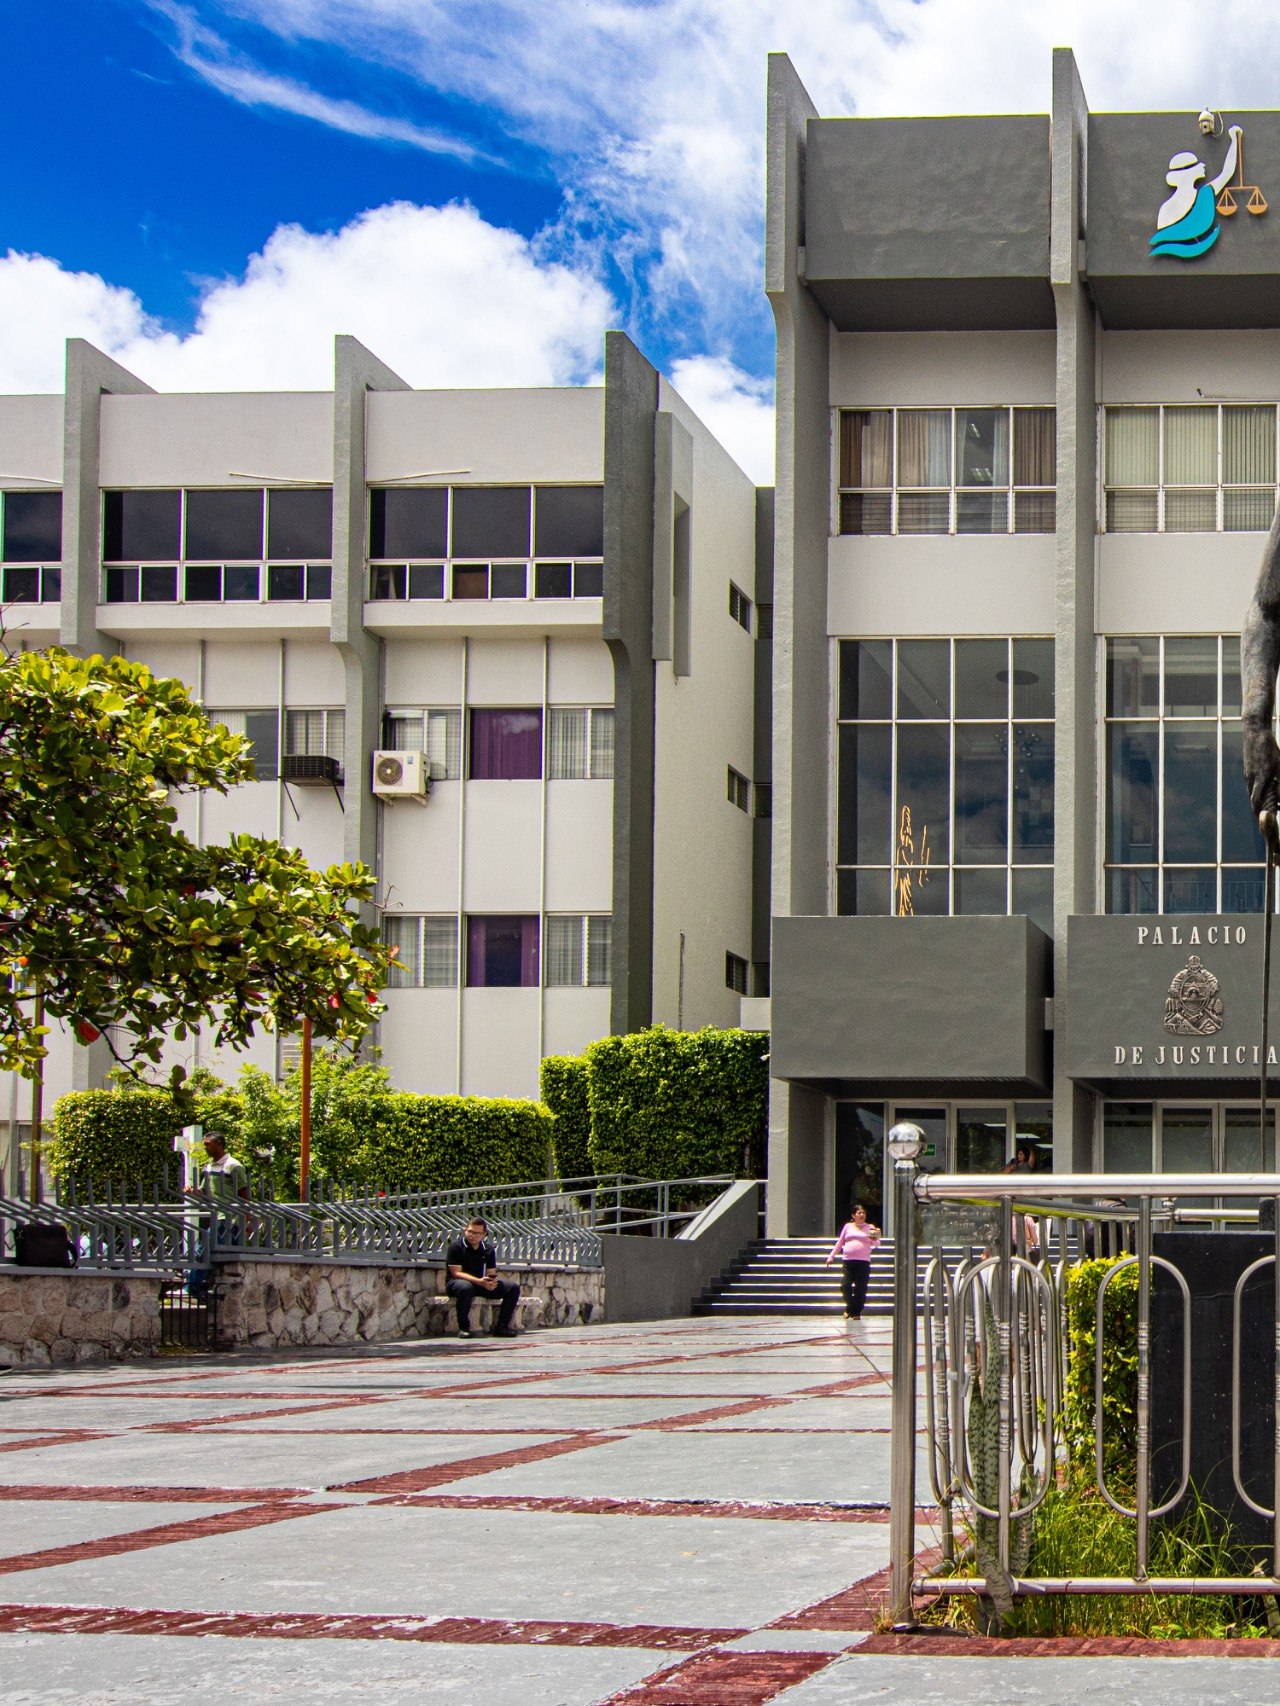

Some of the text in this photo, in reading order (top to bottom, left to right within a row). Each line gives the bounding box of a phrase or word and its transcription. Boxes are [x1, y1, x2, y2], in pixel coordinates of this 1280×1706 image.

[1137, 926, 1247, 945] PALACIO
[1114, 1046, 1279, 1065] DE JUSTICIA
